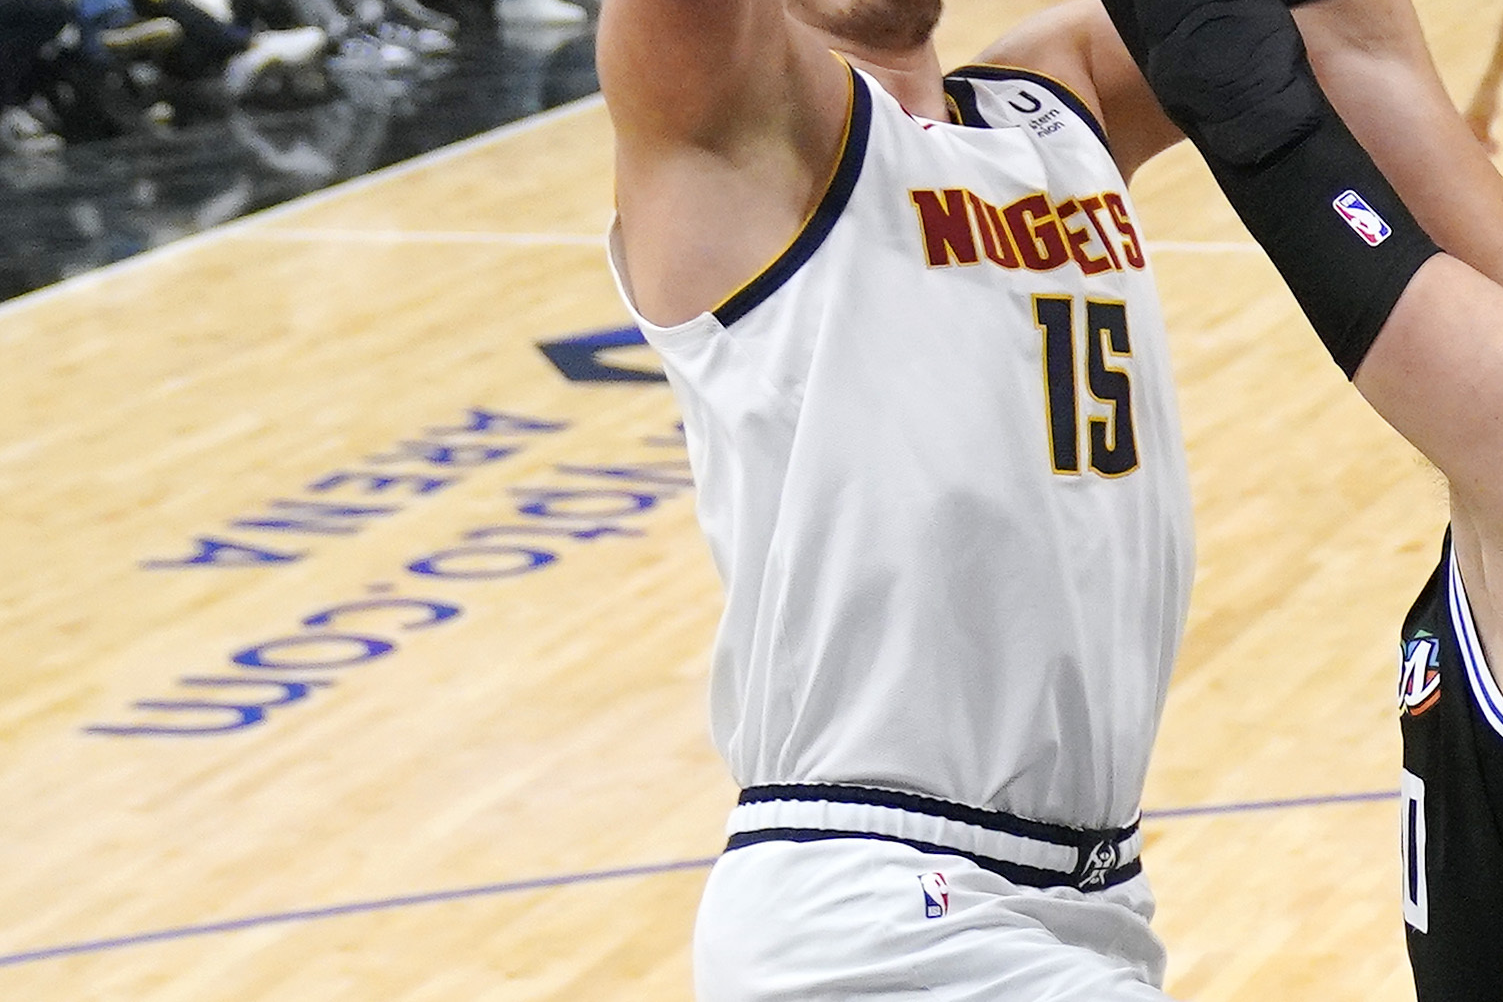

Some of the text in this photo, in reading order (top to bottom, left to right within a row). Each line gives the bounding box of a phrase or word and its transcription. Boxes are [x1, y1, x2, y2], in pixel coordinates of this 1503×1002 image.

[1028, 108, 1060, 130] stern
[1037, 120, 1065, 138] nion
[908, 187, 1147, 277] NUGETS
[1031, 293, 1140, 479] 15
[138, 406, 570, 572] ARENA
[80, 422, 702, 737] ypto.com
